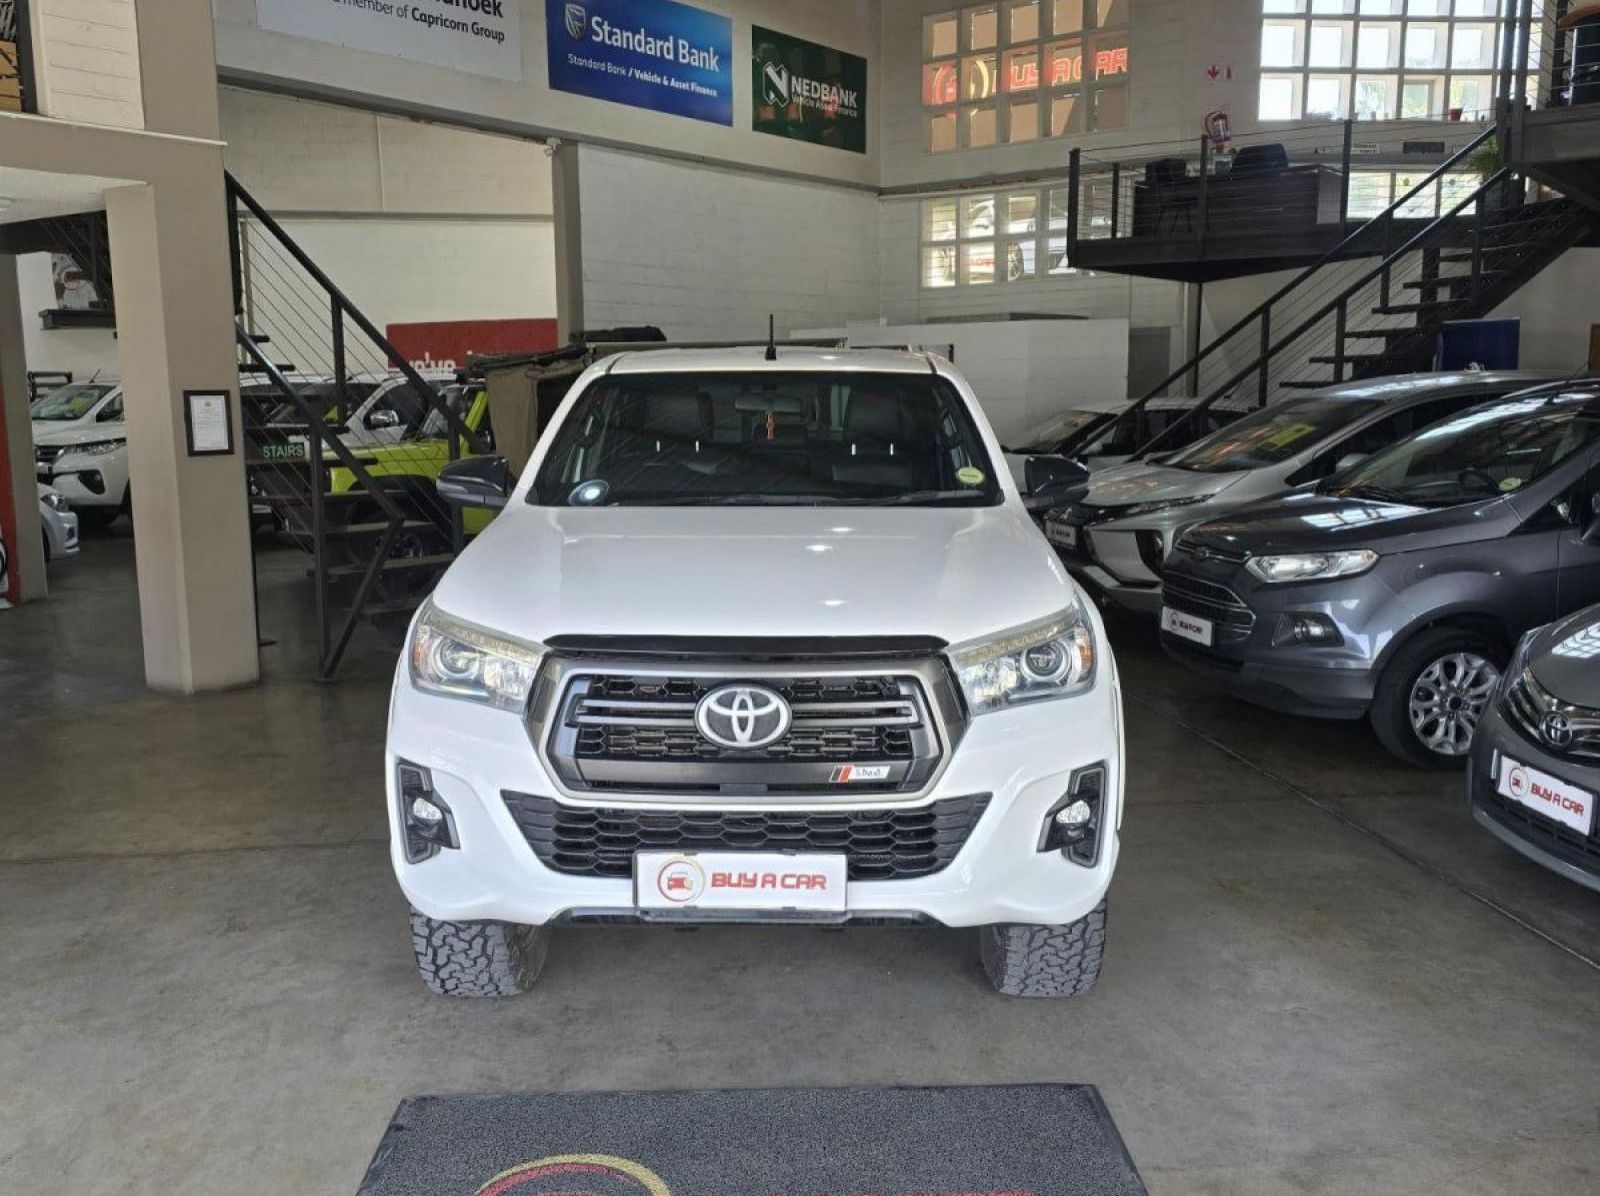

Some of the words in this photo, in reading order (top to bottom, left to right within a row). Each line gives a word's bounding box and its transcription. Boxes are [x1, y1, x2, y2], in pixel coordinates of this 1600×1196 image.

[396, 5, 409, 18] of
[411, 7, 468, 32] Capricorn
[471, 21, 505, 43] Group
[591, 16, 674, 60] Standard
[678, 39, 719, 72] Bank
[568, 53, 606, 71] Standard
[607, 63, 626, 76] Bank
[635, 69, 661, 84] Vehicle
[791, 75, 857, 108] NEDBANK
[263, 445, 304, 459] STAIRS
[1530, 782, 1553, 802] BUY
[1552, 793, 1561, 806] A
[1562, 797, 1585, 817] CAR
[711, 872, 757, 888] BUY
[761, 873, 777, 888] A
[780, 874, 827, 890] CAR
